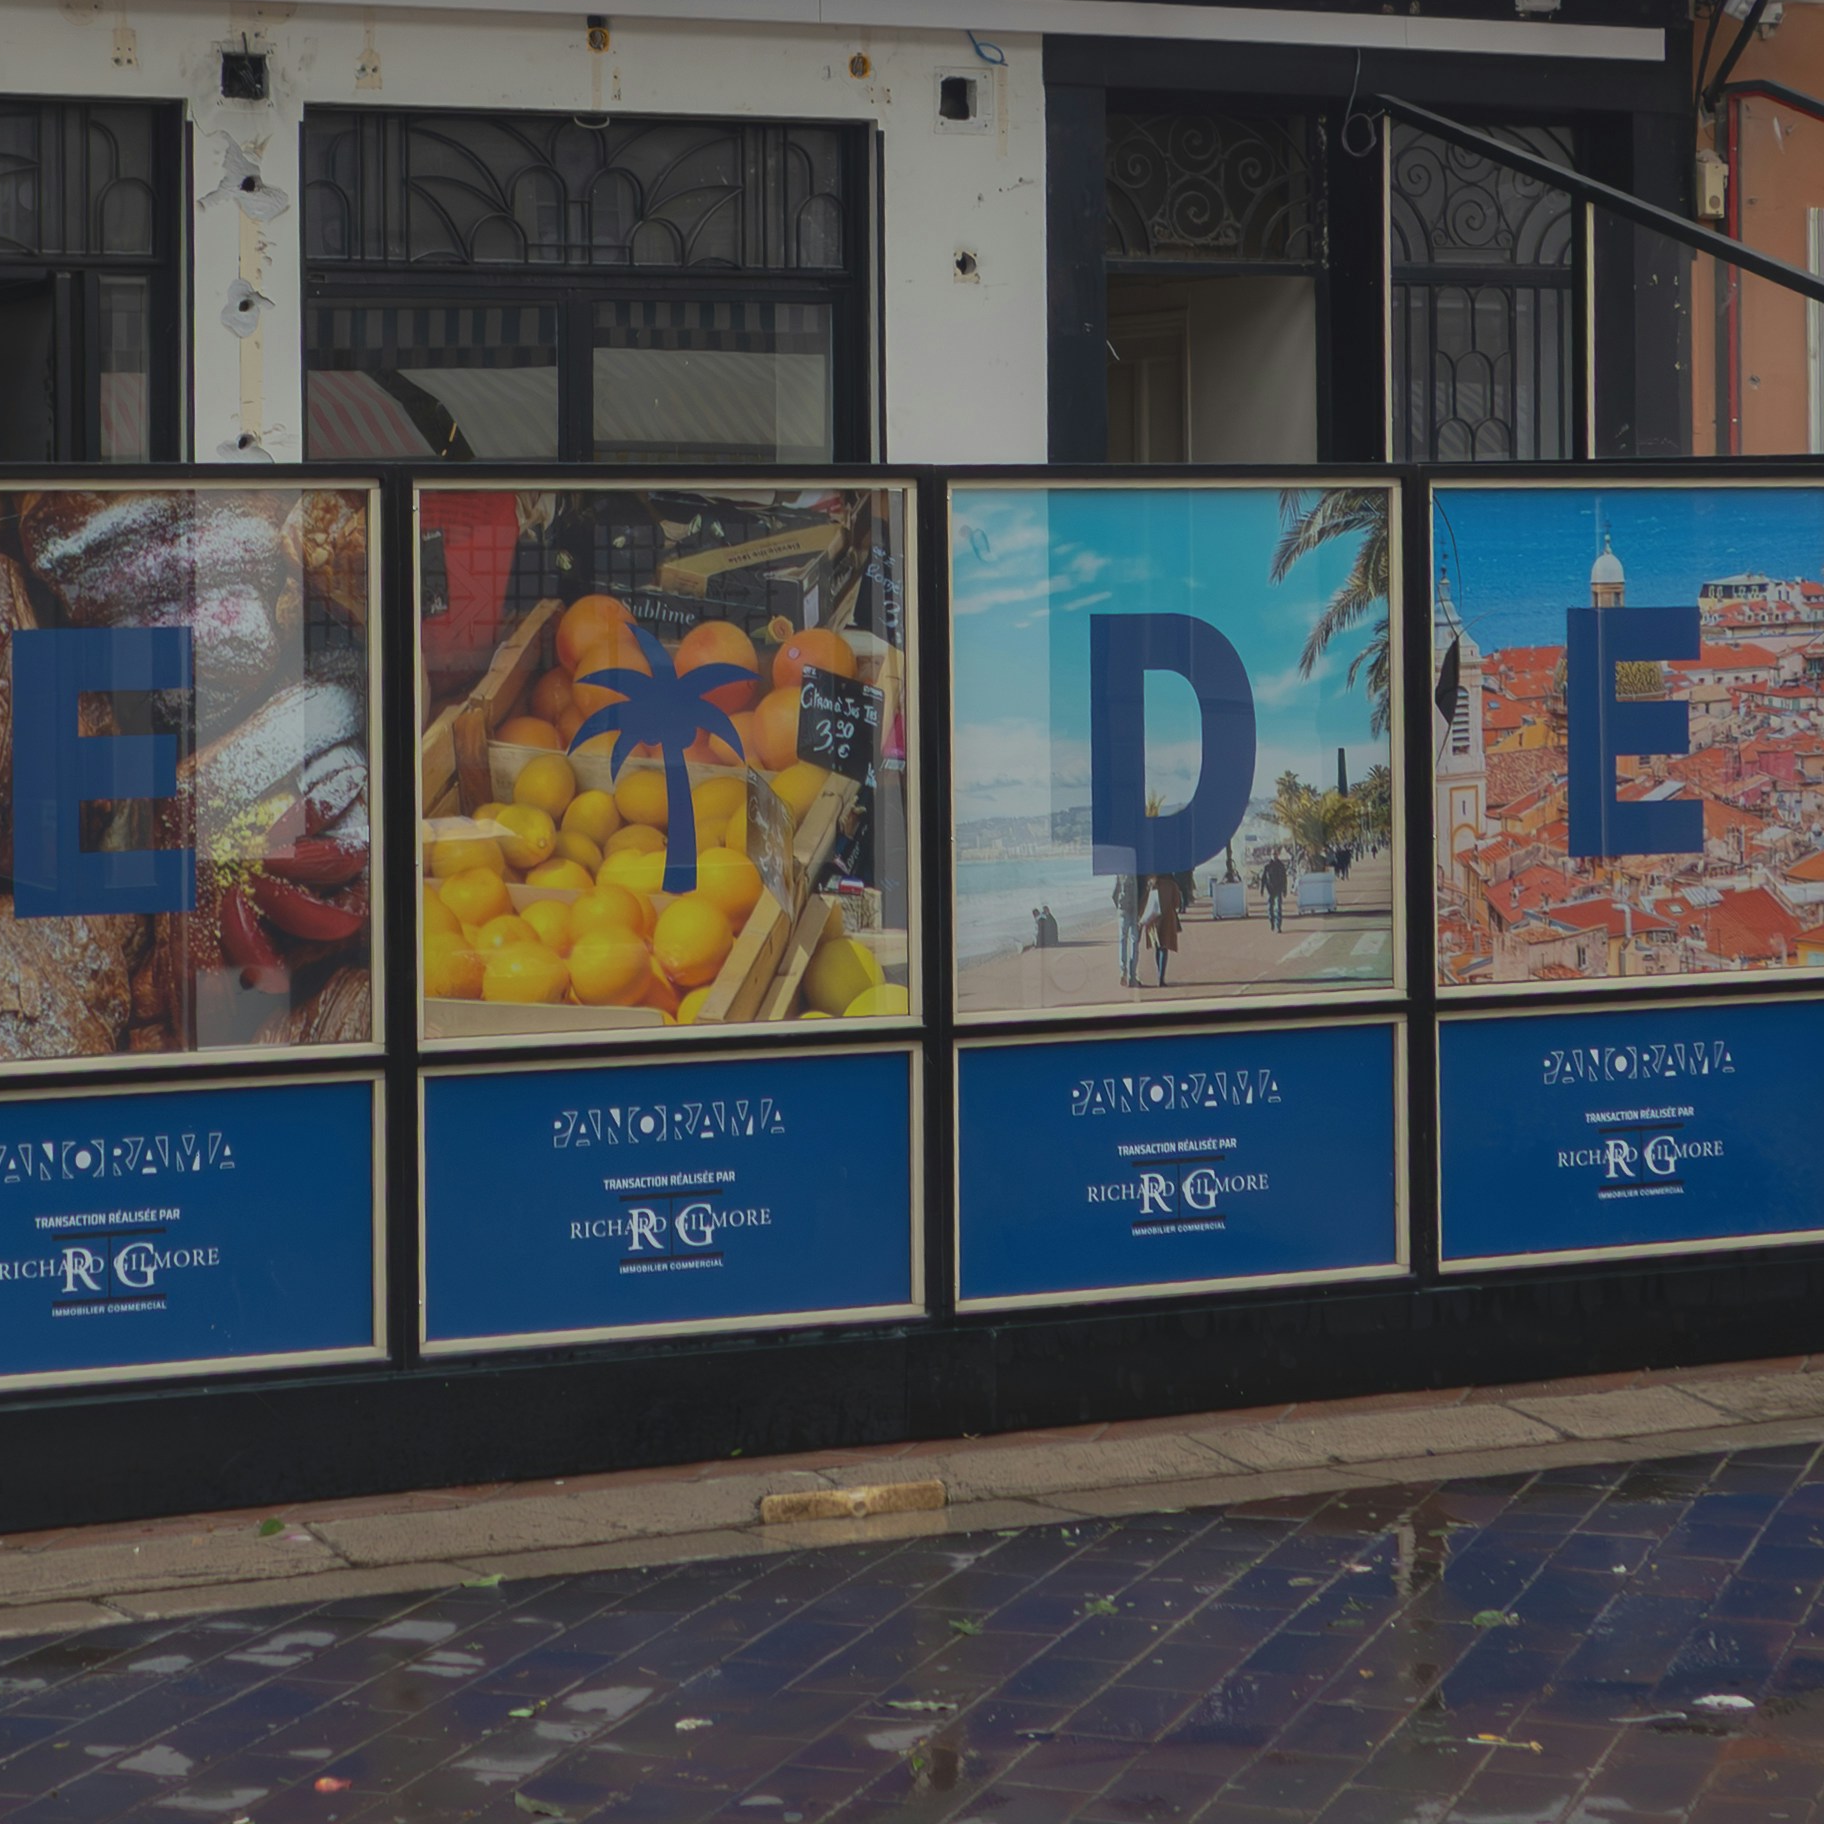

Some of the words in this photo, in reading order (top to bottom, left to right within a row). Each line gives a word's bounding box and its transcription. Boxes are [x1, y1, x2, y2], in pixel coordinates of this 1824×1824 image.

[620, 597, 696, 625] Sublime
[1543, 1041, 1736, 1085] PANORAMA
[1072, 1069, 1281, 1116] PANORAMA
[553, 1098, 785, 1148] PANORAMA
[1585, 1111, 1639, 1124] TRANSACTION
[1678, 1106, 1694, 1116] PAR
[1118, 1142, 1176, 1156] TRANSACTION
[1177, 1139, 1218, 1151] RÉALISÉE
[1219, 1138, 1237, 1148] PAR
[603, 1177, 668, 1191] TRANSACTION
[670, 1172, 714, 1186] RÉALISÉE
[716, 1170, 735, 1182] PAR
[35, 1213, 106, 1229] TRANSACTION
[108, 1210, 157, 1224] RÉALISÉE
[159, 1209, 180, 1220] PAR
[1132, 1226, 1175, 1236] IMMOBILIER
[1177, 1223, 1226, 1232] COMMERCIAL
[620, 1264, 668, 1274] IMMOBILIER
[670, 1260, 723, 1270] COMMERCIAL
[52, 1306, 105, 1317] IMMOBILIER
[107, 1302, 167, 1313] COMMERCIAL
